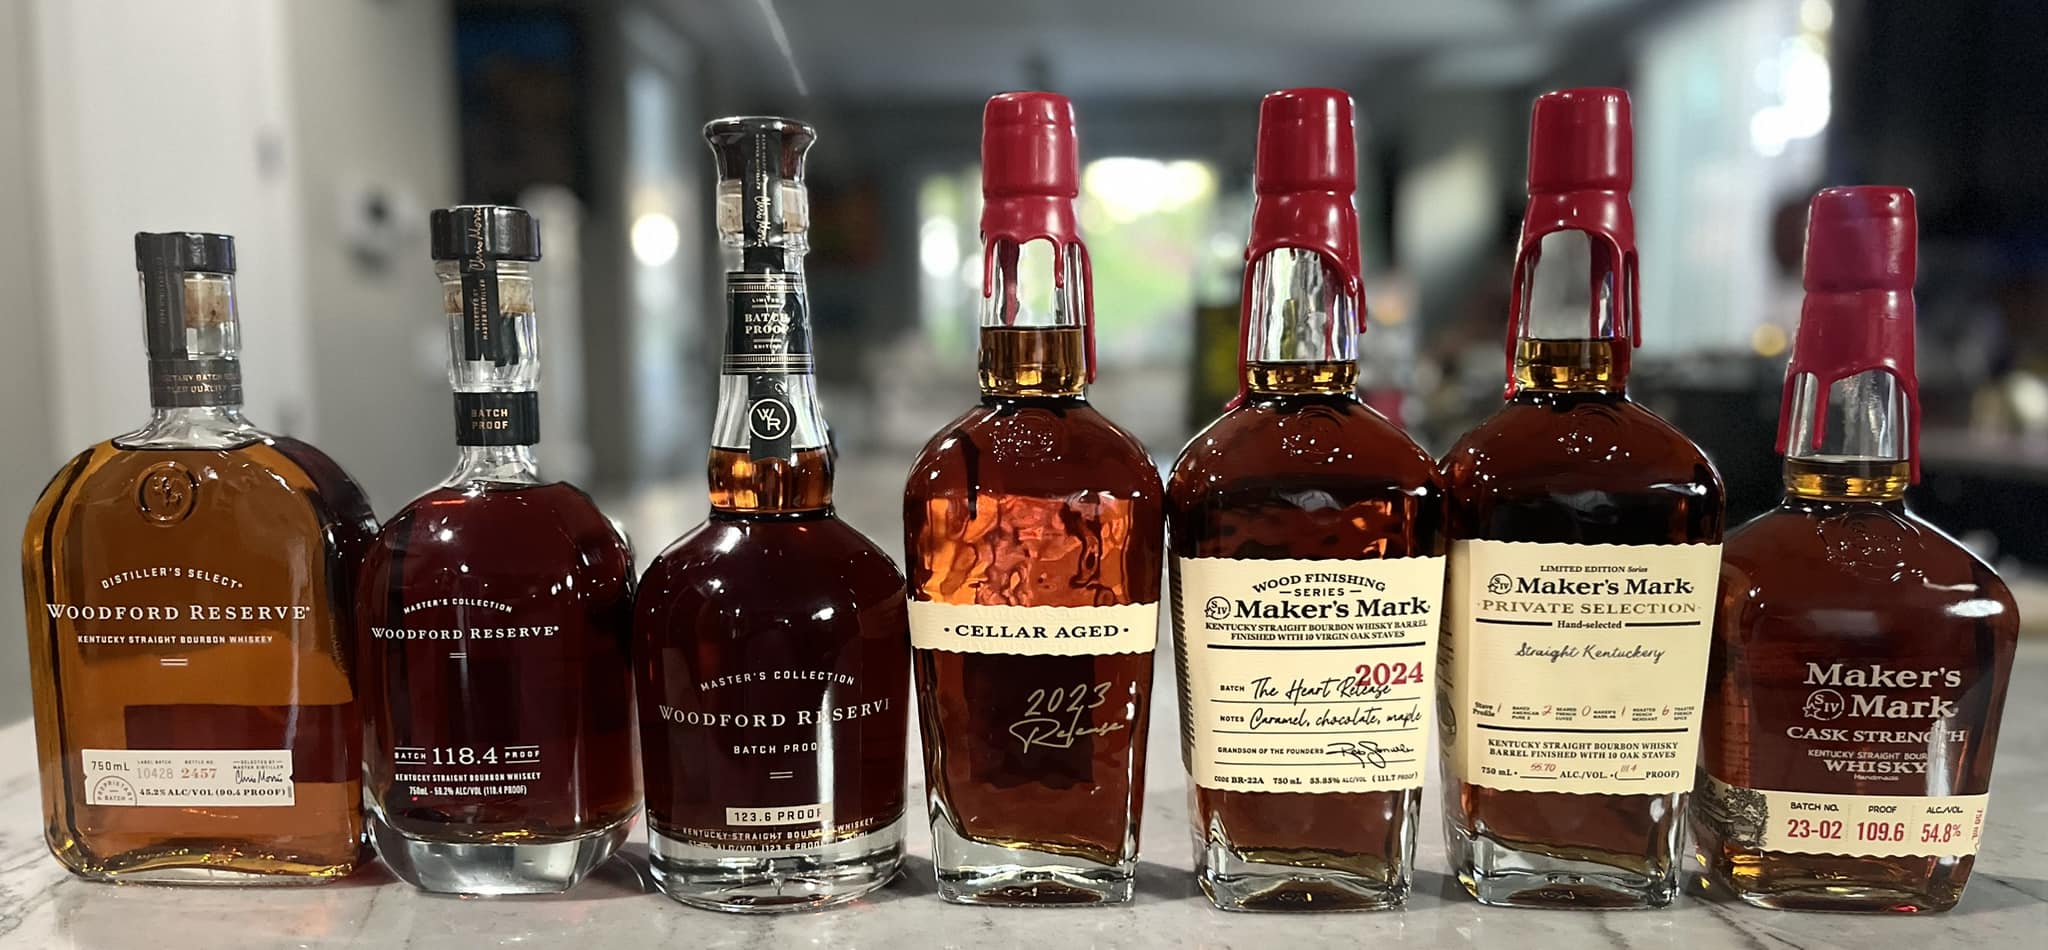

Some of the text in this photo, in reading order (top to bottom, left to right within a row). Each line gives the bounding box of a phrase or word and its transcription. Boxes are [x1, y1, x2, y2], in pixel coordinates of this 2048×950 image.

[471, 408, 509, 418] BATCH
[471, 420, 509, 430] PROOF
[1540, 565, 1583, 573] LIMITED
[1584, 565, 1626, 573] EDITION
[101, 567, 238, 589] DISTILLER'S SELECT
[1252, 573, 1386, 594] WOOD FINISHING
[1294, 588, 1345, 597] SERIES
[1515, 577, 1692, 595] Maker's Mark
[46, 603, 306, 621] WOODFORD RESERVE
[403, 598, 513, 615] MASTER'S COLLECTION
[1233, 597, 1429, 619] Maker's Mark
[1481, 600, 1696, 615] PRIVATE SELECTION
[955, 625, 1119, 638] CELLAR AGED
[1205, 619, 1428, 632] KENTUCKY STRAIGHT BOURBON WHISKY BARREL
[1556, 620, 1623, 630] Hand-selected
[77, 635, 273, 644] KENTUCKY STRAIGHT BOURBON WHISKEY
[371, 626, 554, 640] WOODFORD RESERVE
[1231, 630, 1405, 641] FINISHED WITH 10 VIRGIN OAK STAVES
[1515, 642, 1579, 663] Straight
[700, 670, 855, 692] MASTER'S COLLECTION
[1355, 662, 1424, 687] 2024
[1803, 662, 1962, 689] Maker's
[1250, 676, 1279, 699] The
[1285, 678, 1341, 706] Heart
[1024, 681, 1112, 717] 2023
[1847, 694, 1956, 719] Mark
[659, 704, 786, 728] WOODFORD
[1219, 715, 1245, 723] NOTES
[1250, 703, 1423, 730] Caramel, chocolate, maple
[1009, 705, 1124, 753] Release
[1786, 727, 1849, 741] CASK
[733, 742, 818, 755] BATCH PROO
[1488, 739, 1542, 749] KENTUCKY
[1543, 742, 1593, 750] STRAIGHT
[1641, 742, 1679, 750] WHISKY
[394, 747, 541, 765] BATCH 118.4 PROOF
[1217, 747, 1257, 755] GRANDSON
[1258, 747, 1269, 755] OF
[1286, 748, 1324, 756] FOUNDERS
[1489, 748, 1677, 759] BARREL FINISHED WITH 10 OAK STAVES
[1807, 749, 1900, 760] KENTUCKY STRAIGHT
[181, 767, 217, 779] 2457
[1481, 766, 1496, 775] 750
[1824, 760, 1928, 774] WHISKY
[395, 771, 542, 782] KENTUCKY STRAIGHT BOURBON WHISKEY
[1231, 777, 1264, 785] BR-22A
[1273, 777, 1288, 785] 750
[243, 788, 286, 797] PROOF)
[455, 786, 482, 796] ALC/VOL
[503, 785, 528, 796] PROOF)
[1790, 802, 1821, 811] BATCH
[1868, 805, 1898, 813] PROOF
[734, 812, 772, 822] 123.6
[682, 816, 874, 841] KENTUCKY STRAIGHT WHISKEY
[1787, 819, 1843, 839] 23-02
[1857, 821, 1905, 841] 109.6
